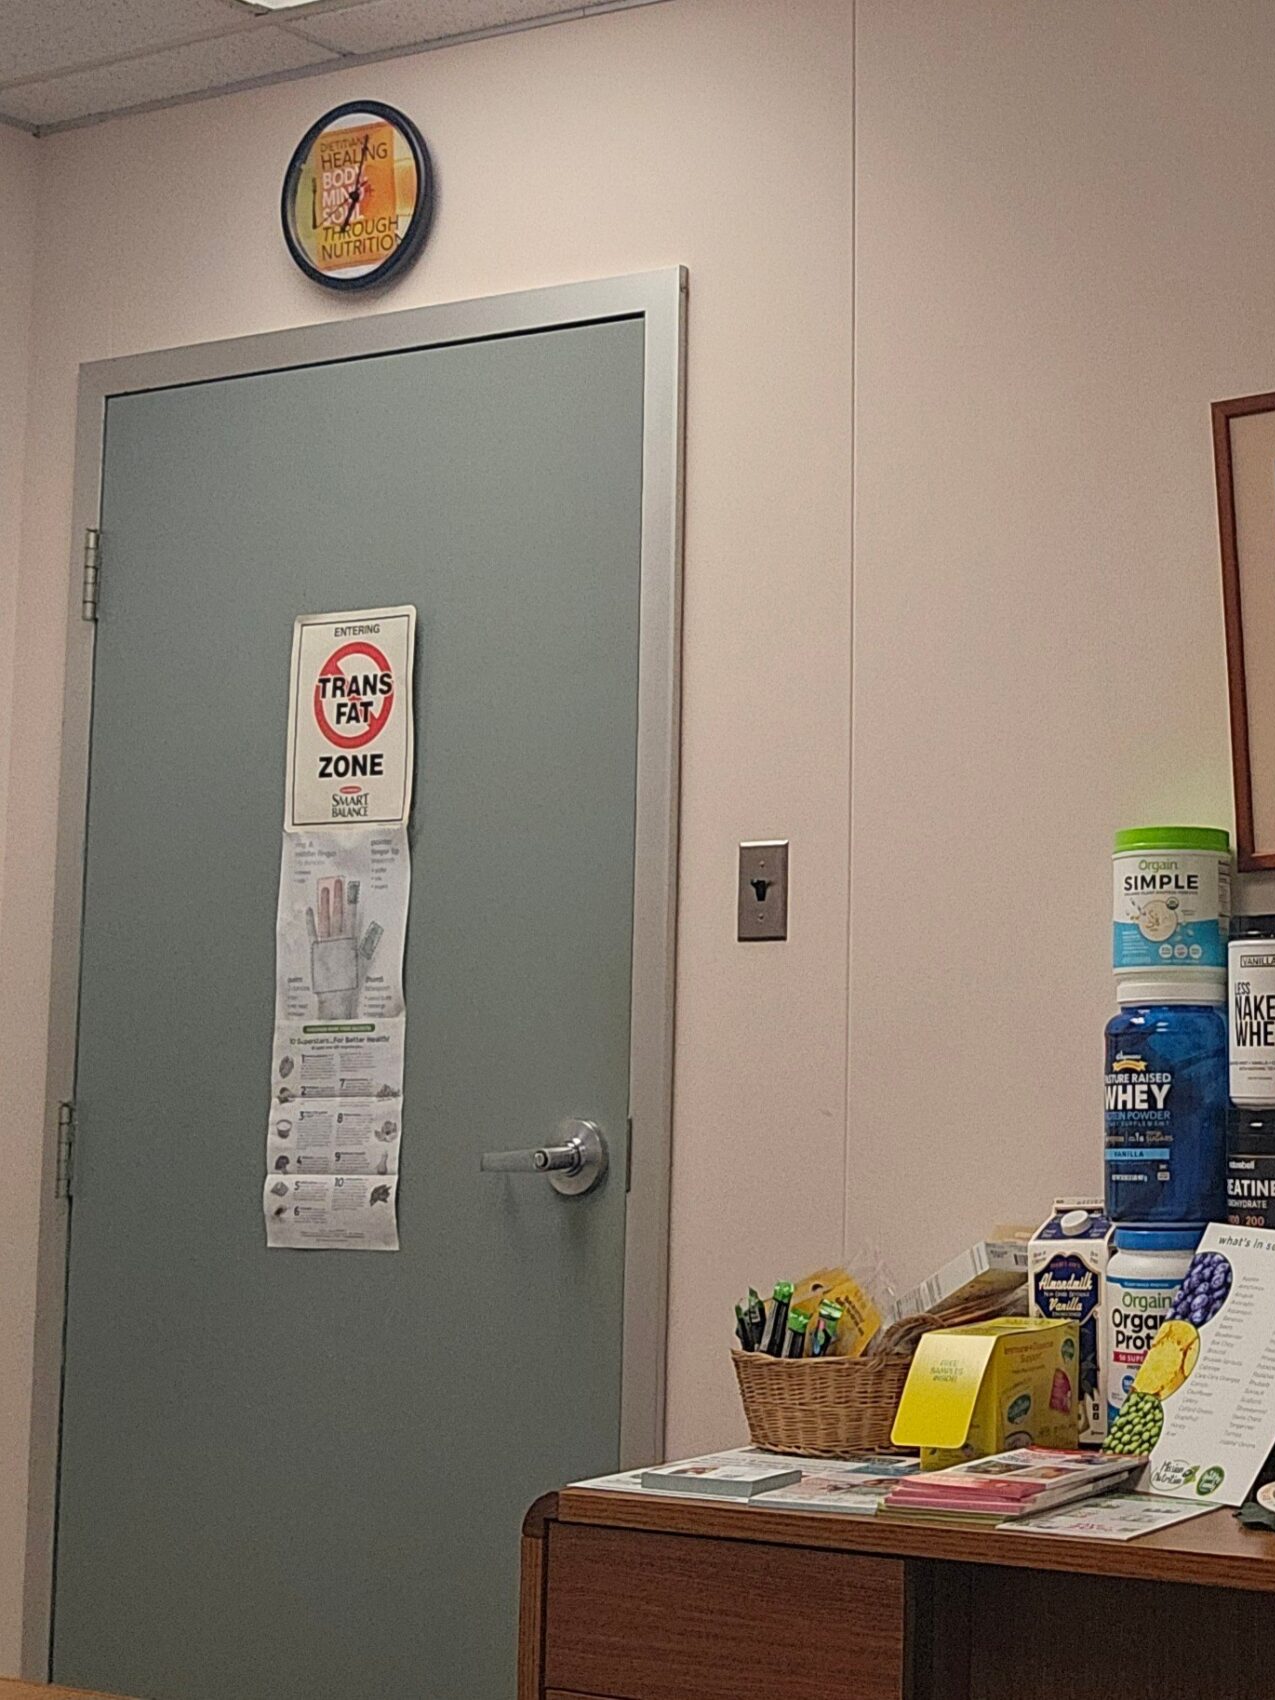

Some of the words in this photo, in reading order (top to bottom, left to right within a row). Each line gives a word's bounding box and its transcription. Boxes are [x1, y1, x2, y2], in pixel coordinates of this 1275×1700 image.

[321, 142, 388, 170] HEALNG
[323, 215, 398, 242] THROUGH
[334, 624, 380, 637] ENTERING
[318, 673, 393, 699] TRANS
[335, 701, 373, 724] FAT
[318, 754, 384, 778] ZONE
[332, 792, 369, 807] SMART
[332, 806, 368, 818] BALANCE
[1139, 859, 1178, 873] Orgain
[1124, 874, 1199, 891] SIMPLE
[1235, 981, 1251, 996] LESS
[1132, 1073, 1171, 1083] RAISED
[301, 1086, 307, 1096] 2
[1105, 1084, 1171, 1110] WHEY
[299, 1111, 305, 1121] 3
[1127, 1111, 1170, 1120] POWDER
[294, 1181, 300, 1191] 5
[294, 1207, 300, 1216] 6
[1245, 1216, 1265, 1226] 200
[1219, 1236, 1250, 1248] what's
[1253, 1238, 1263, 1248] in
[1039, 1272, 1093, 1291] Almondmilk
[1049, 1297, 1083, 1311] Vanilla
[1122, 1292, 1172, 1312] Orgain
